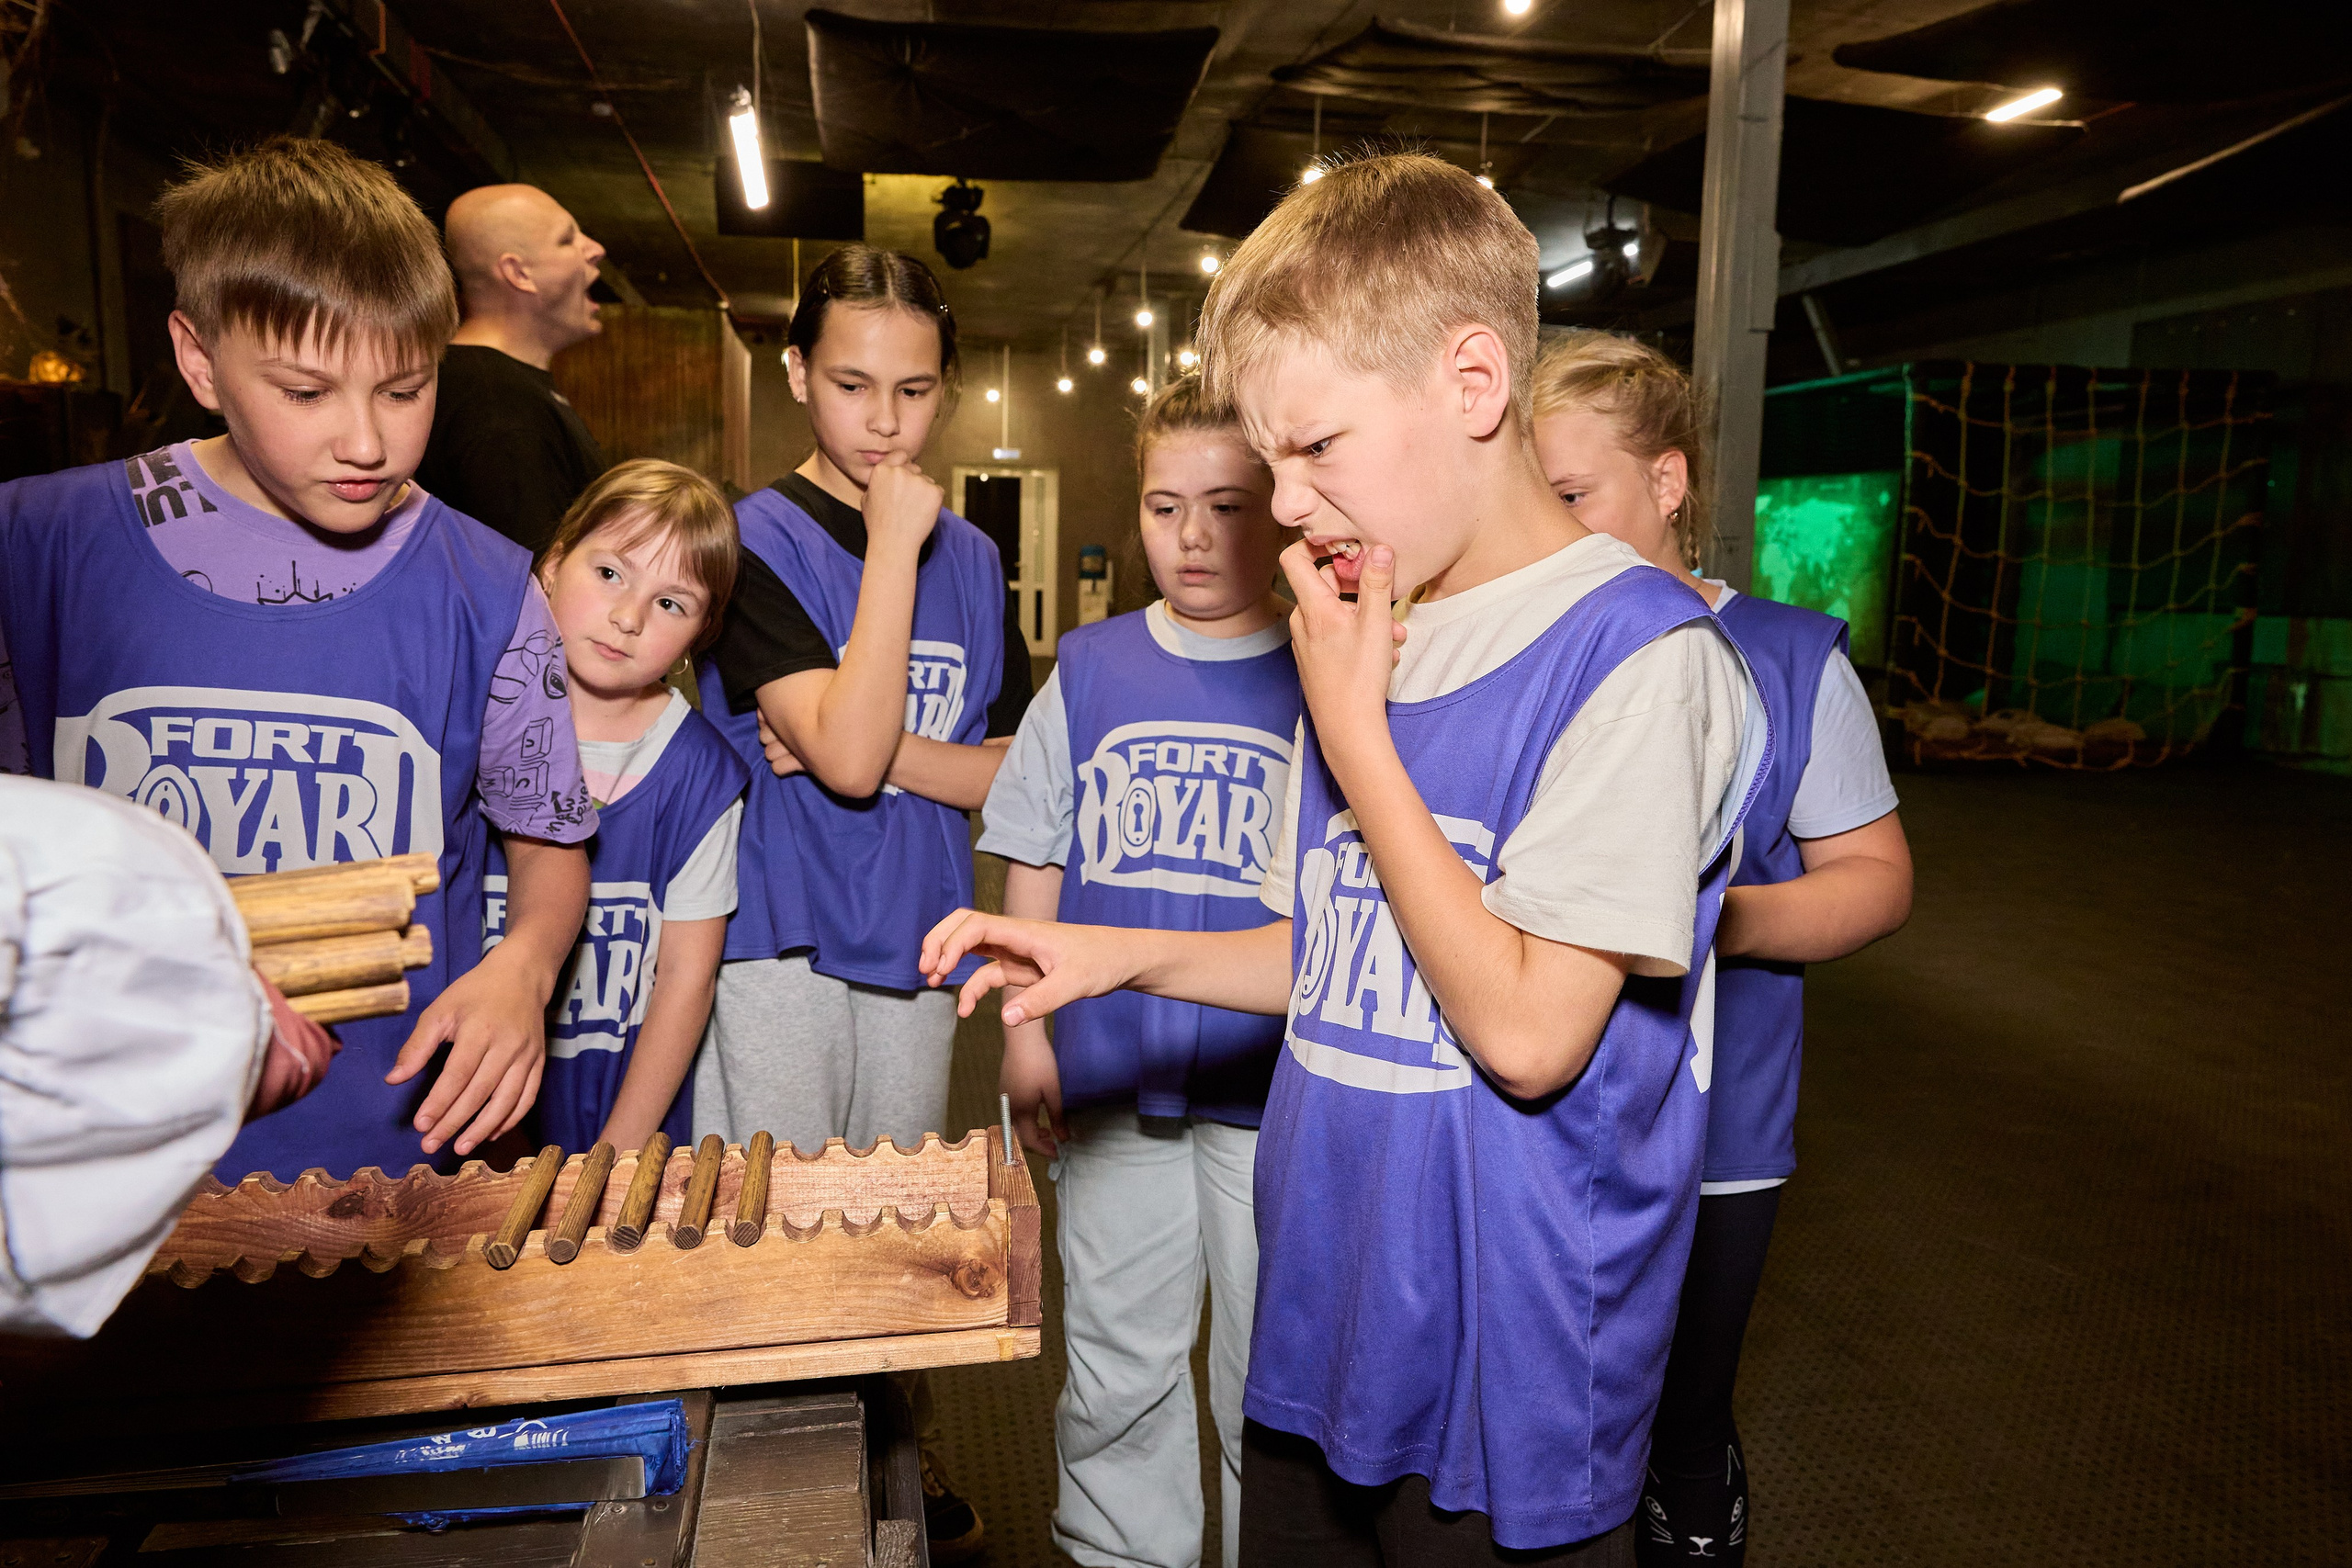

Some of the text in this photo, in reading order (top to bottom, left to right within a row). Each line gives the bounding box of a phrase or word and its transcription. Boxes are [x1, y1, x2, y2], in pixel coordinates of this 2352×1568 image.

[150, 716, 355, 764] FORT
[1129, 741, 1261, 779] FORT
[1335, 841, 1381, 888] FO
